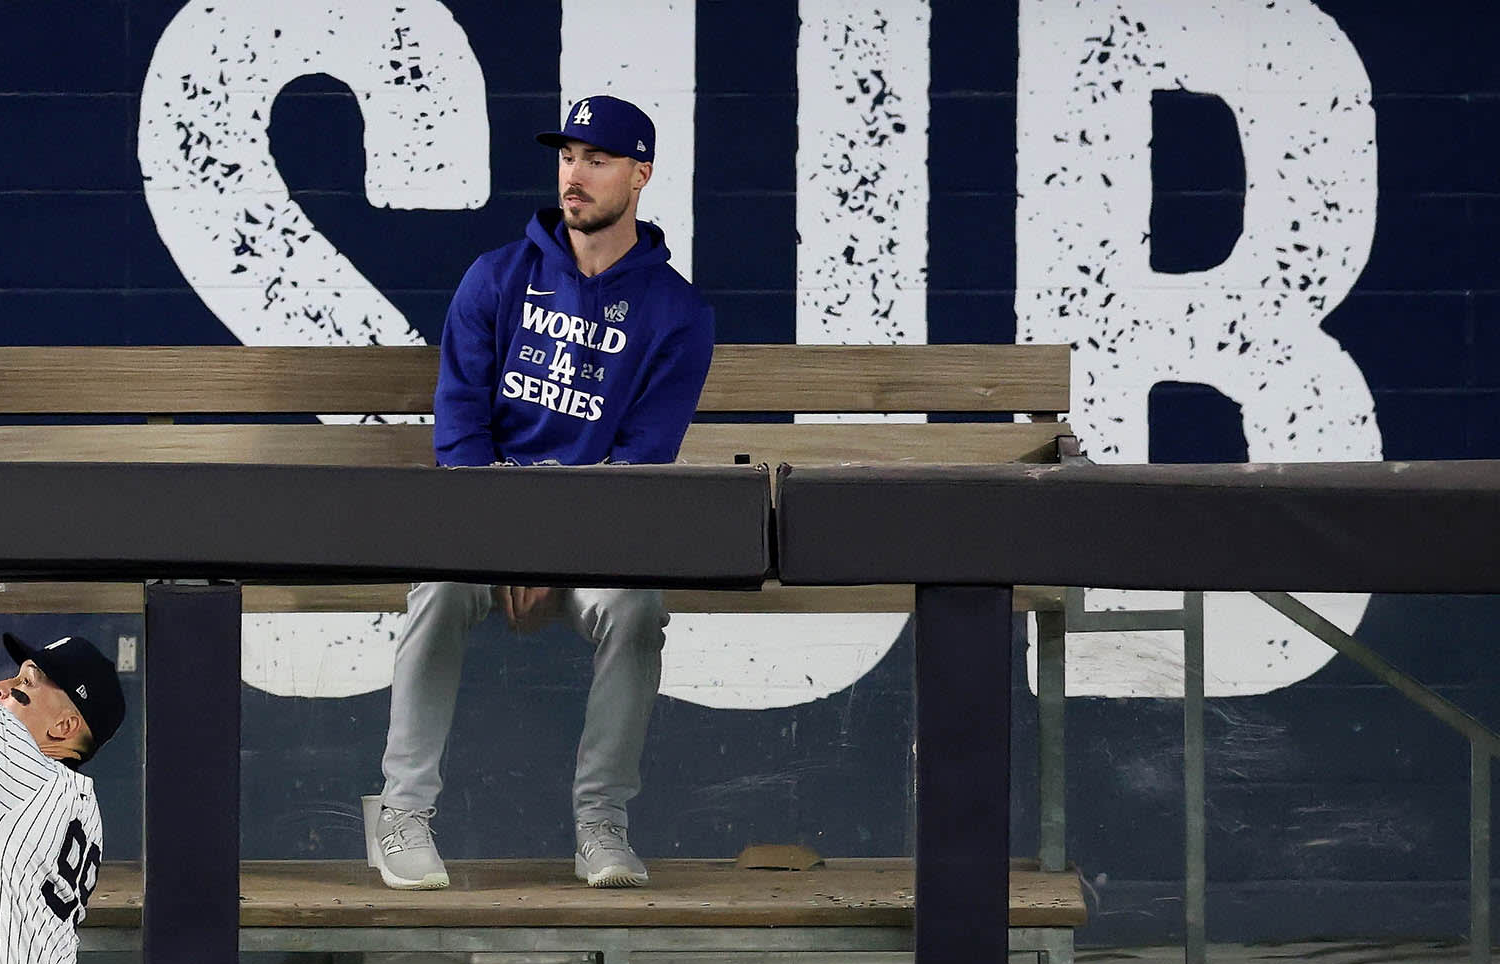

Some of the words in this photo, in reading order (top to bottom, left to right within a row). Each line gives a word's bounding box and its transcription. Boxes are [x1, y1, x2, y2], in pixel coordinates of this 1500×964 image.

[573, 101, 592, 125] LA
[522, 301, 627, 354] WORLD
[138, 0, 1385, 709] SUB
[518, 344, 545, 365] 20
[580, 363, 605, 383] 24
[502, 371, 605, 422] SERIES
[40, 817, 102, 930] 99
